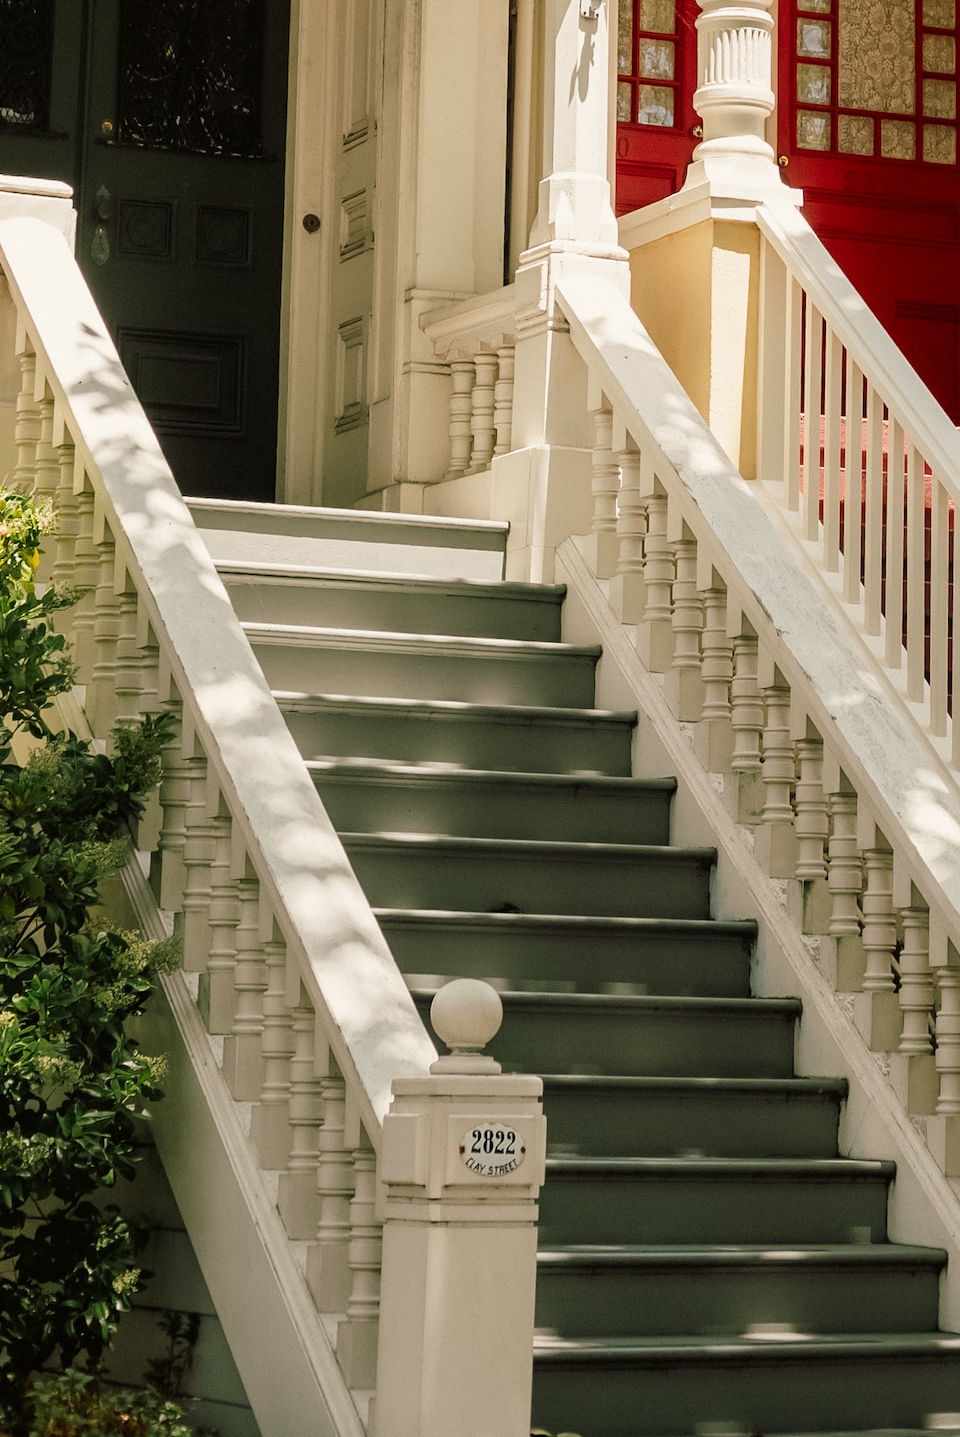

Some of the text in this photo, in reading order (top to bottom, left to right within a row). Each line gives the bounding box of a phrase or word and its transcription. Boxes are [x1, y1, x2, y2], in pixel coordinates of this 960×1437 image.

[471, 1129, 516, 1155] 2822
[465, 1157, 519, 1175] CLAY STREET
